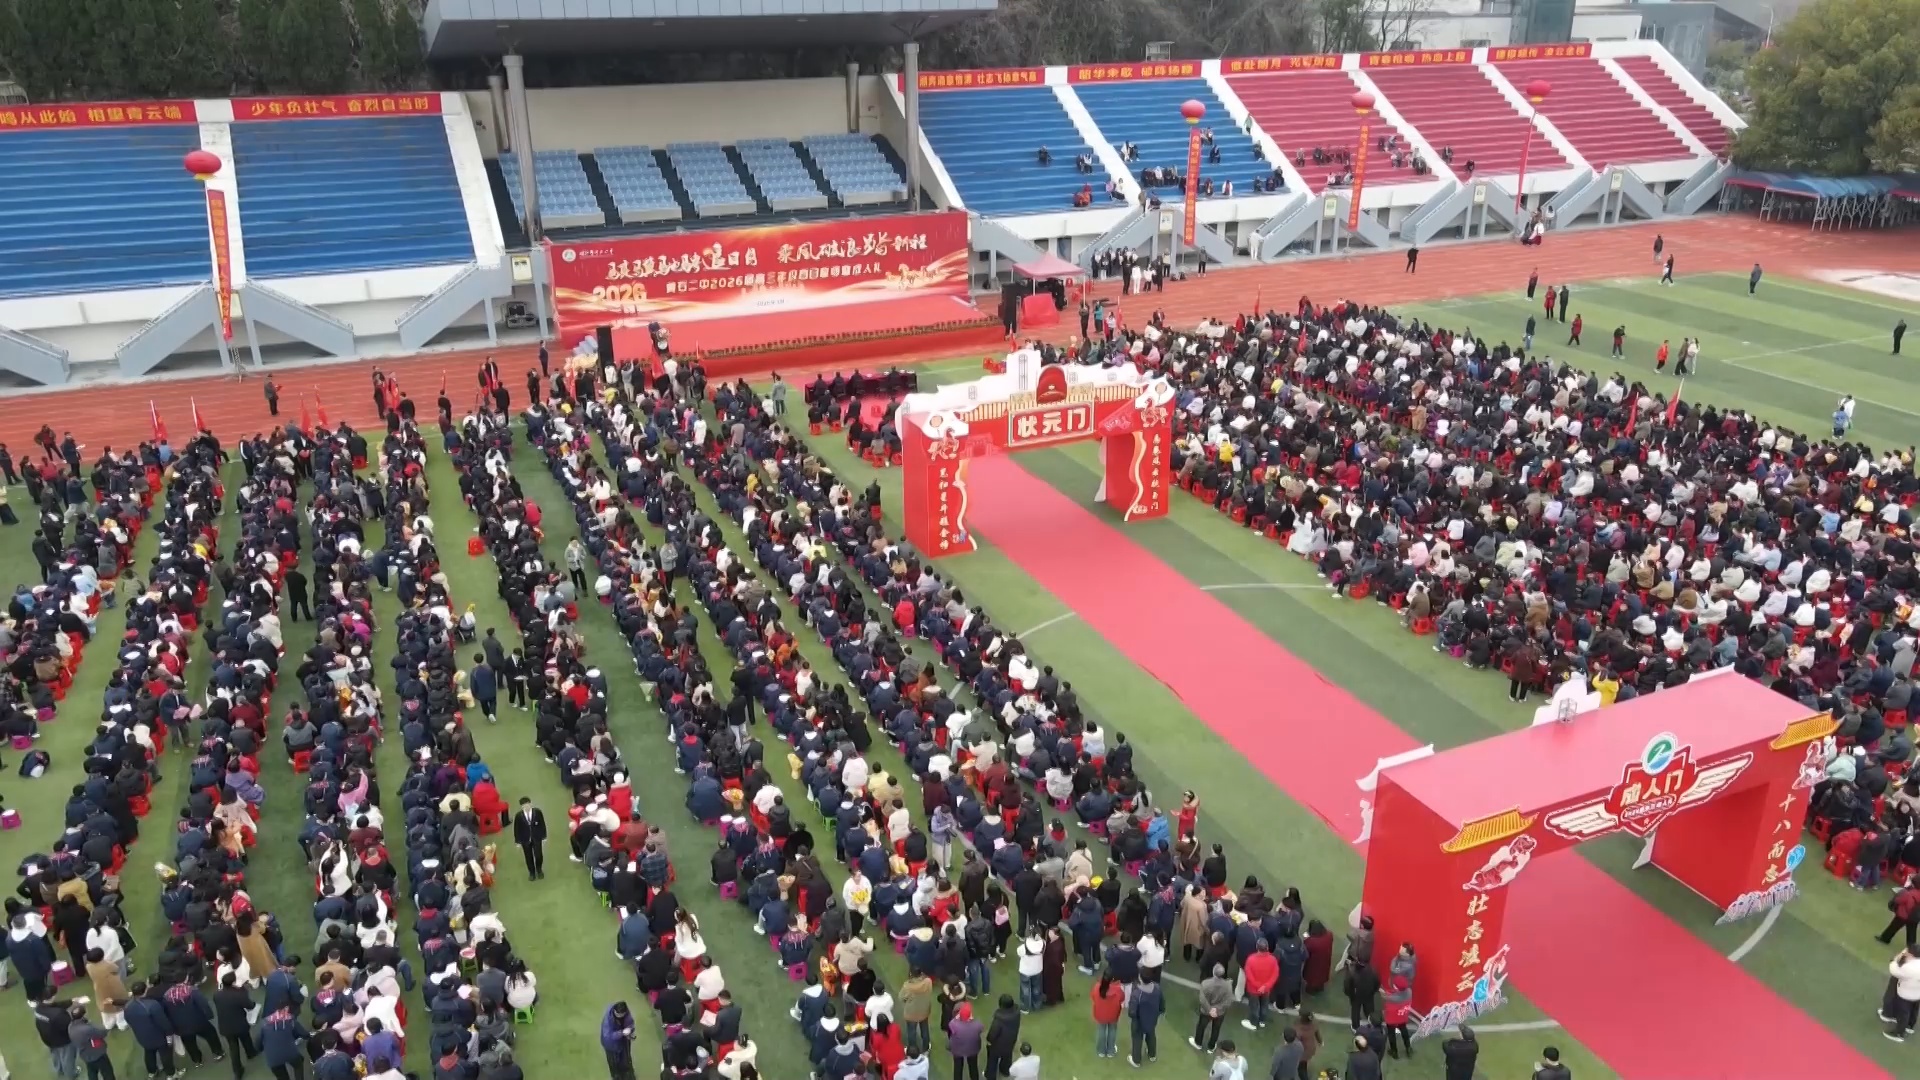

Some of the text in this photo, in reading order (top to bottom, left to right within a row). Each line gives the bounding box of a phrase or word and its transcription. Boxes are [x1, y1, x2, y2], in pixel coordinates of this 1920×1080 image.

[251, 96, 428, 116] 少年负壮气 奋烈自当时
[592, 282, 648, 302] 2026
[1017, 407, 1086, 438] 状元门
[1620, 768, 1684, 807] 成人门
[1762, 793, 1796, 885] 十八而志
[1456, 893, 1490, 992] 壮志凌云
